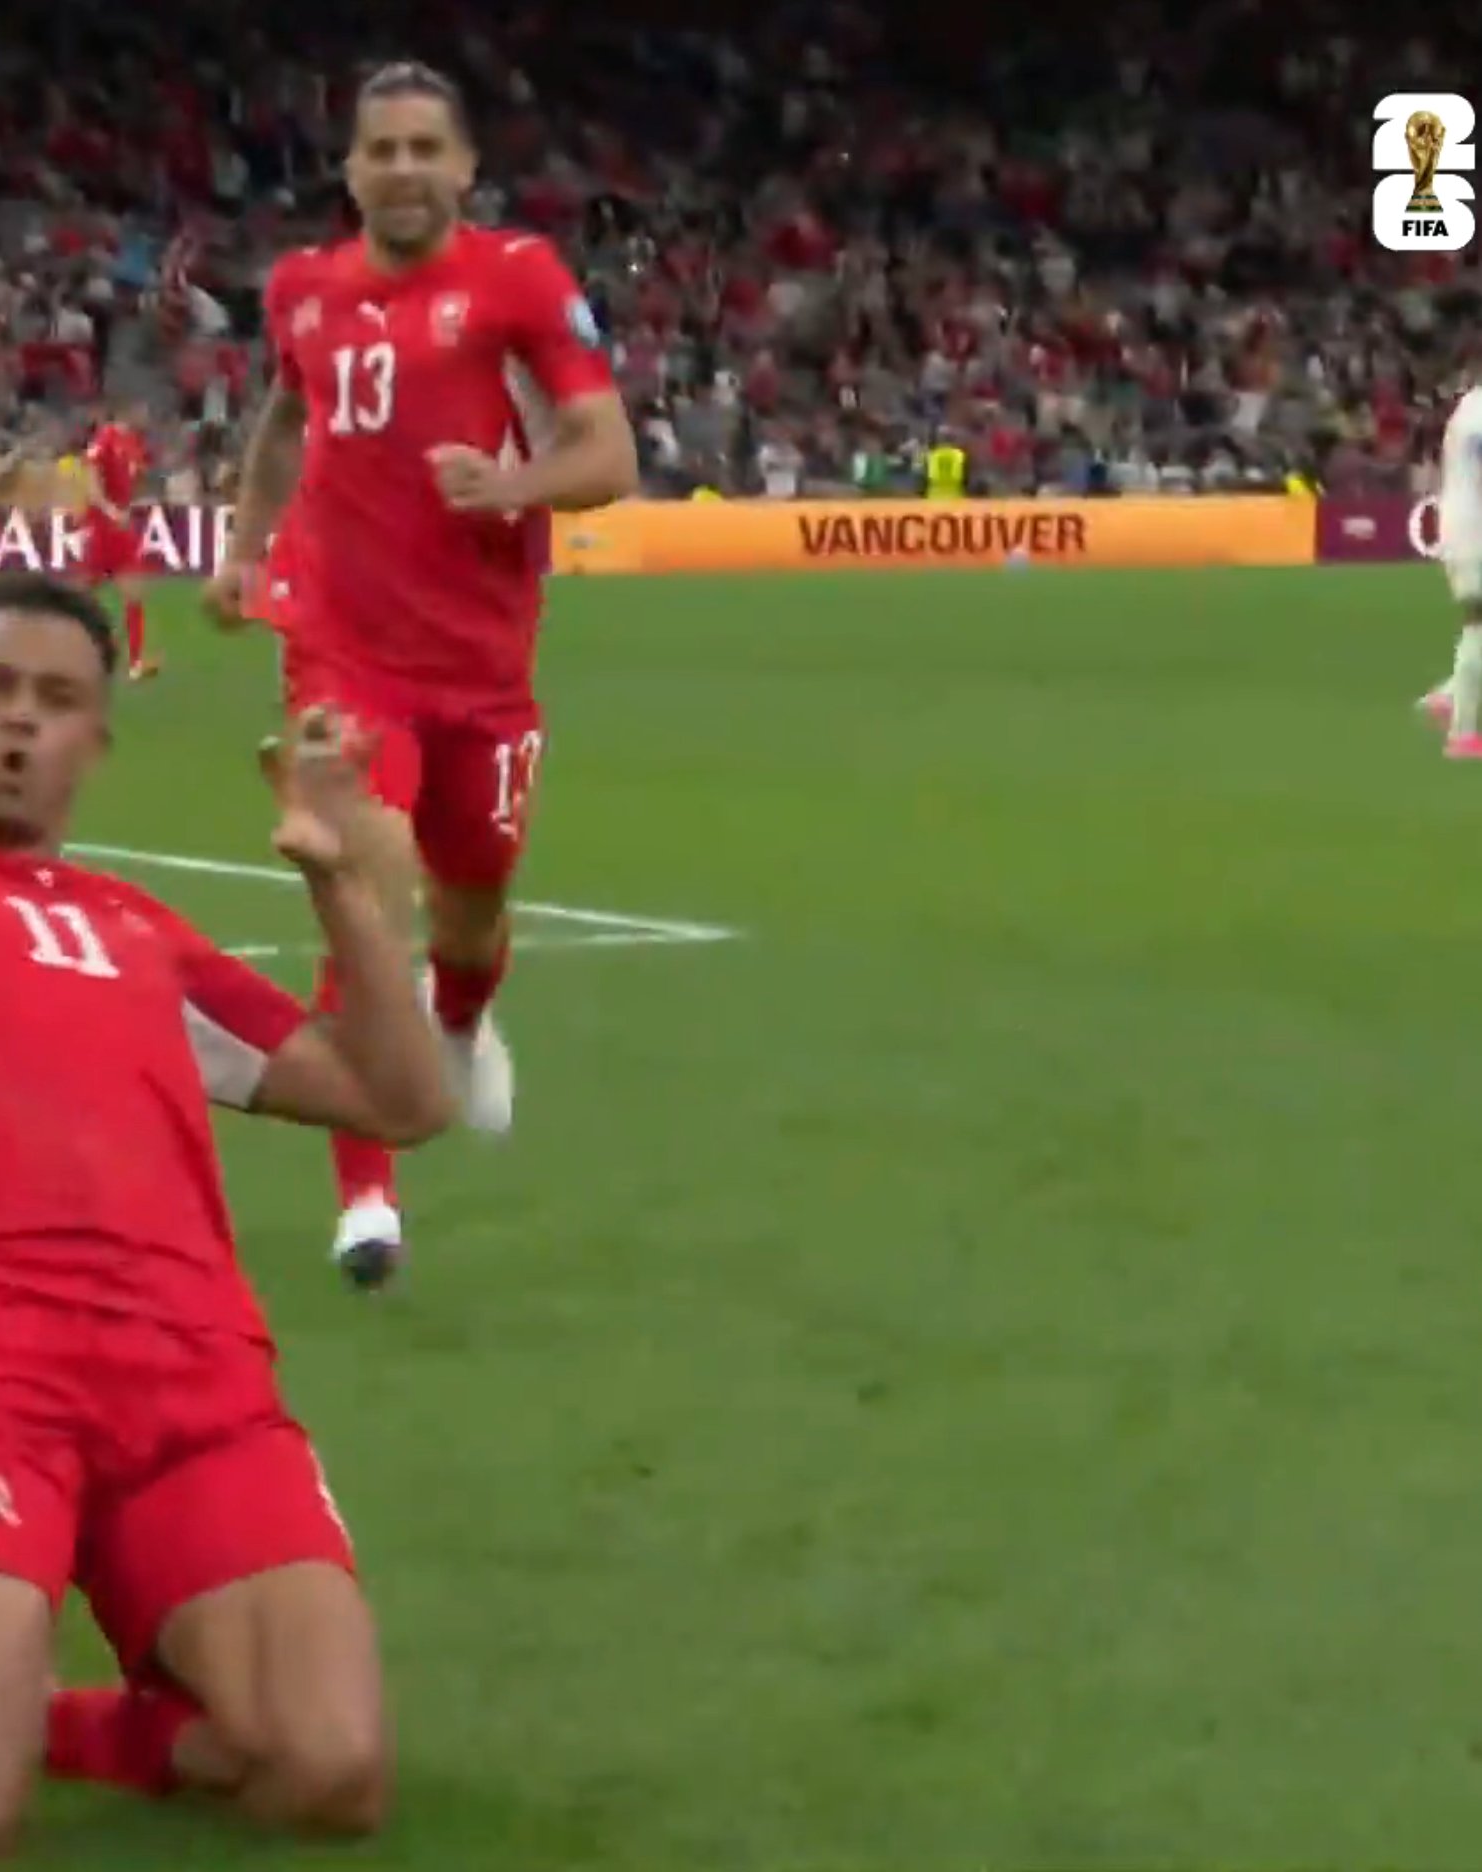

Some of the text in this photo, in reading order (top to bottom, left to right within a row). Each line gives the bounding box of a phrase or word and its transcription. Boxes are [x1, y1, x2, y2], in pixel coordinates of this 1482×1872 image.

[329, 342, 395, 434] 13
[798, 513, 1086, 556] VANCOUVER
[5, 896, 120, 978] 11
